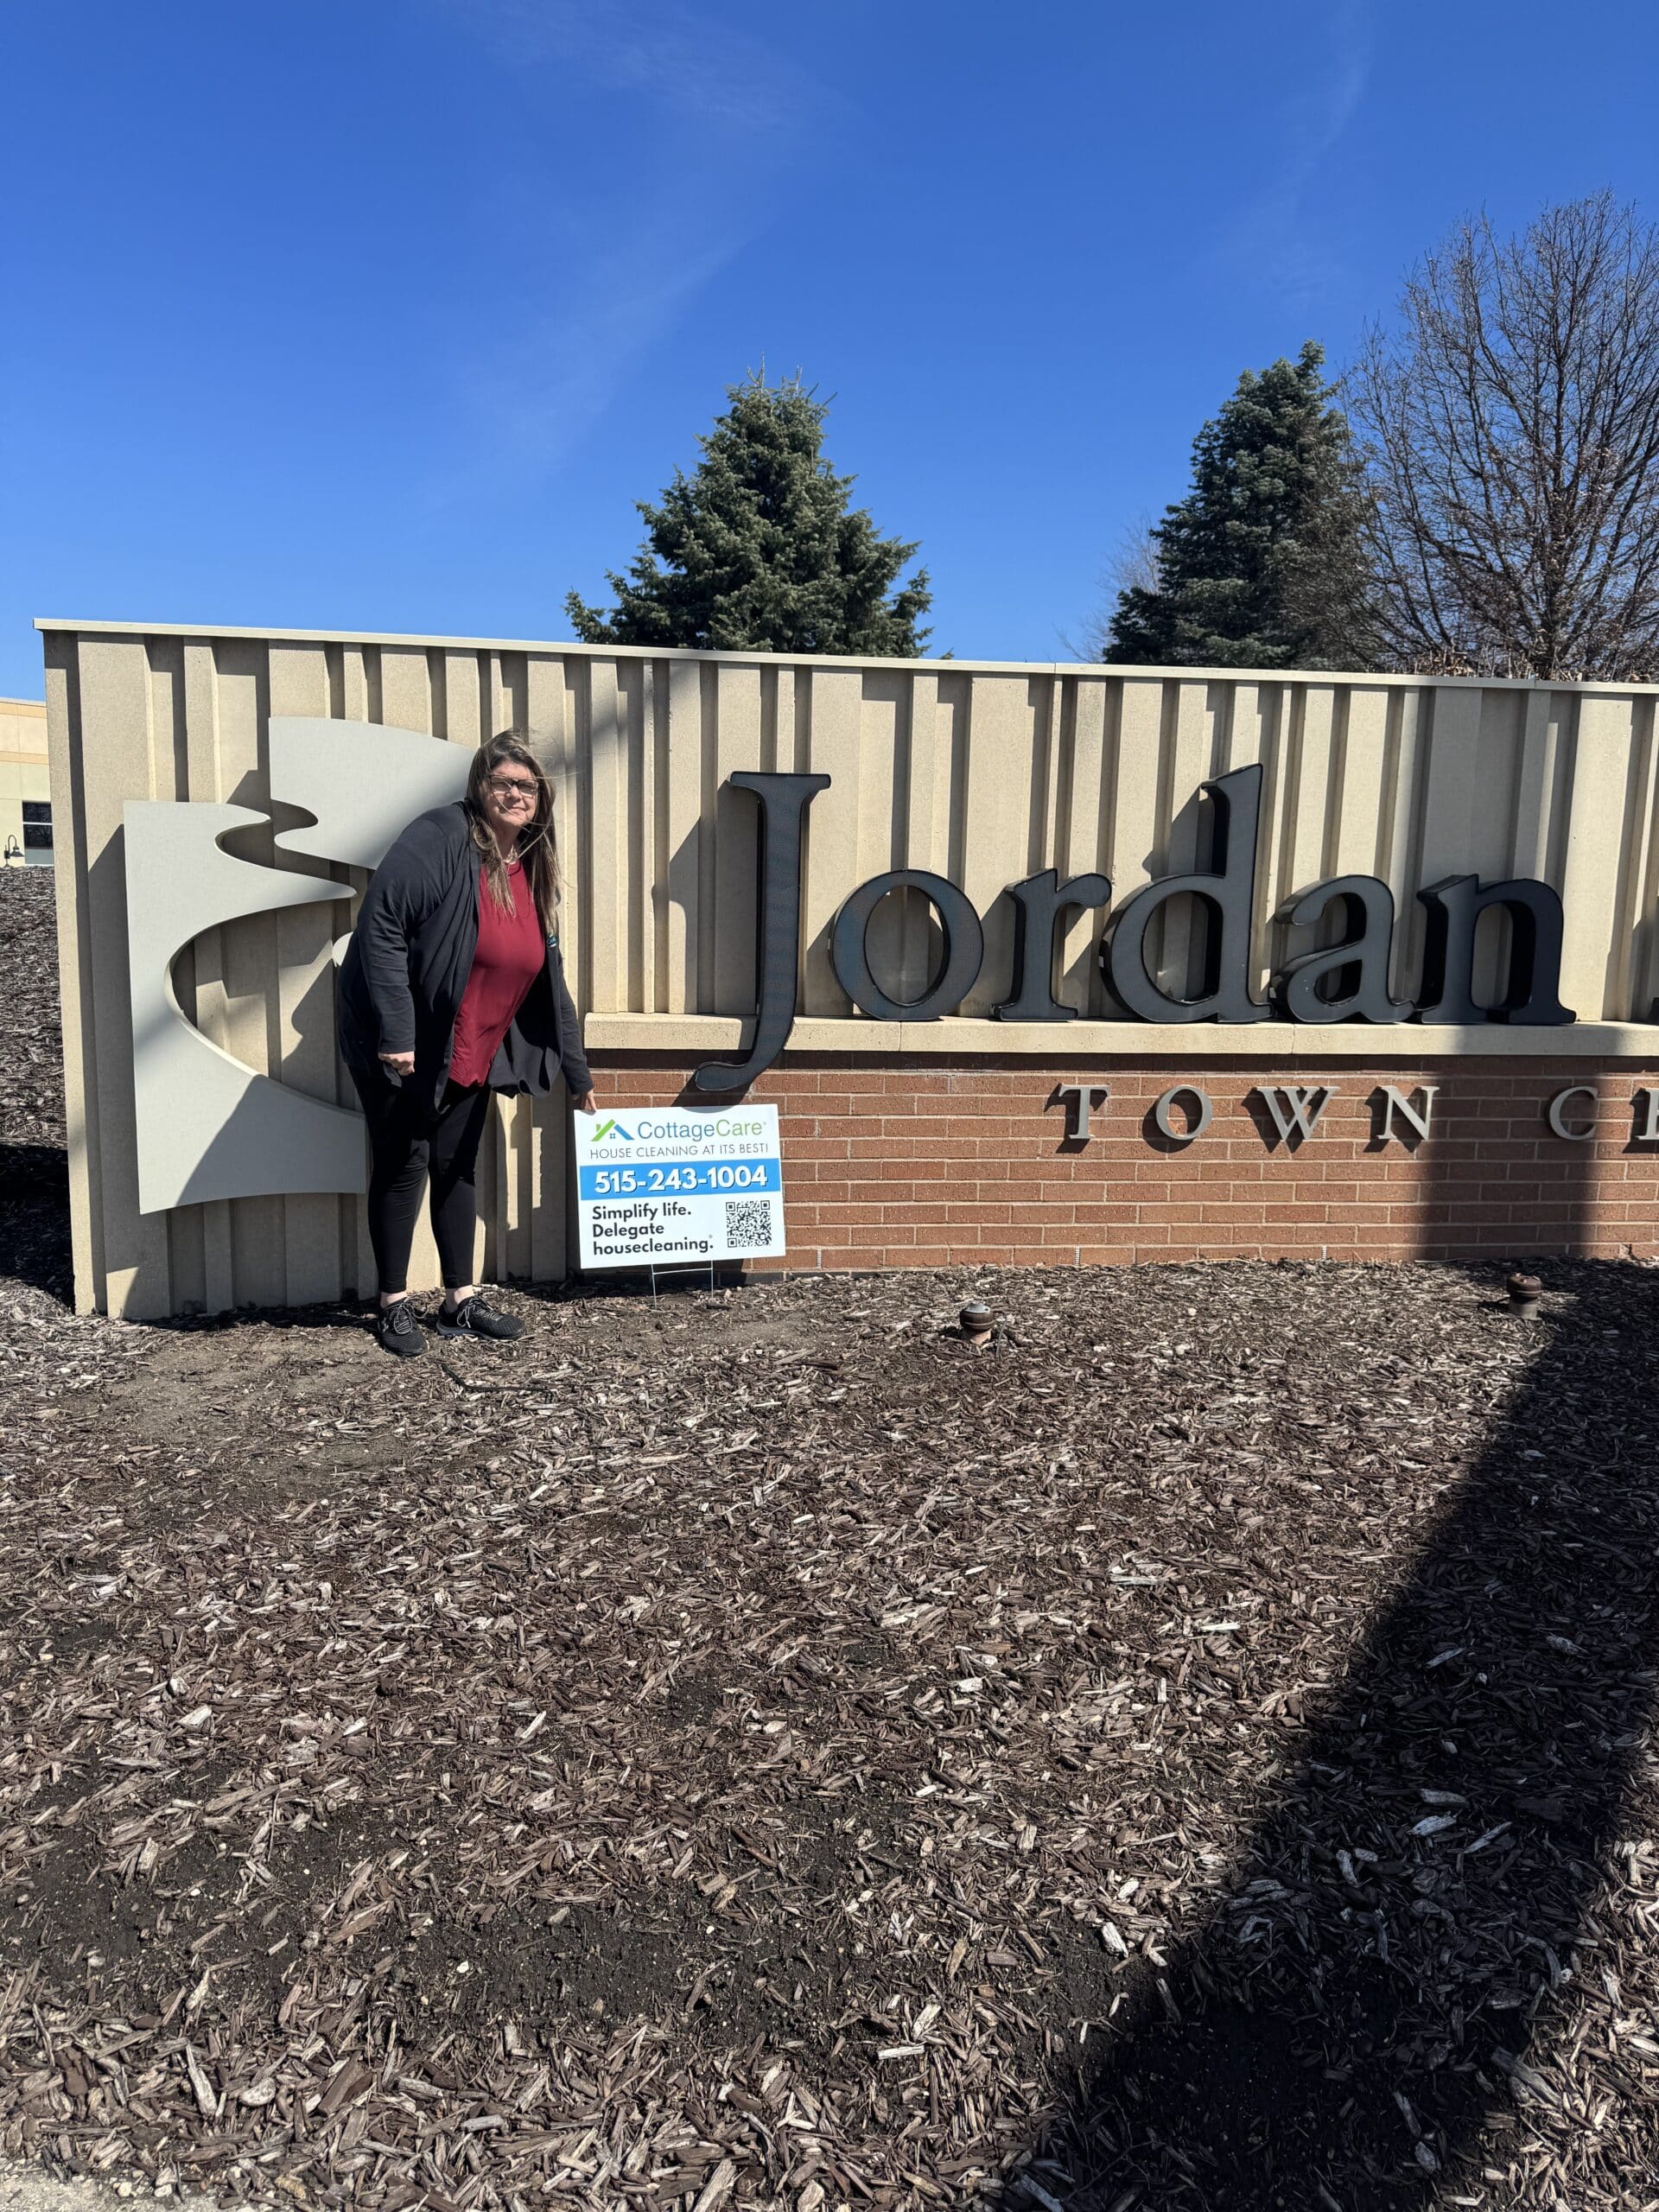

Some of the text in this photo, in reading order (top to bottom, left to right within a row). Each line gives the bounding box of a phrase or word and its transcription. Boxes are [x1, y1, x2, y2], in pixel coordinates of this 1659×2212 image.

[694, 763, 1577, 1091] Jordan
[1058, 1084, 1440, 1142] TOWN
[590, 1142, 768, 1159] HOUSE CLEANING AT ITS BEST!
[594, 1165, 768, 1193] 515-243-1004
[592, 1201, 692, 1222] Simplify life.
[593, 1223, 664, 1240] Delegate
[593, 1236, 715, 1255] housecleaning.
